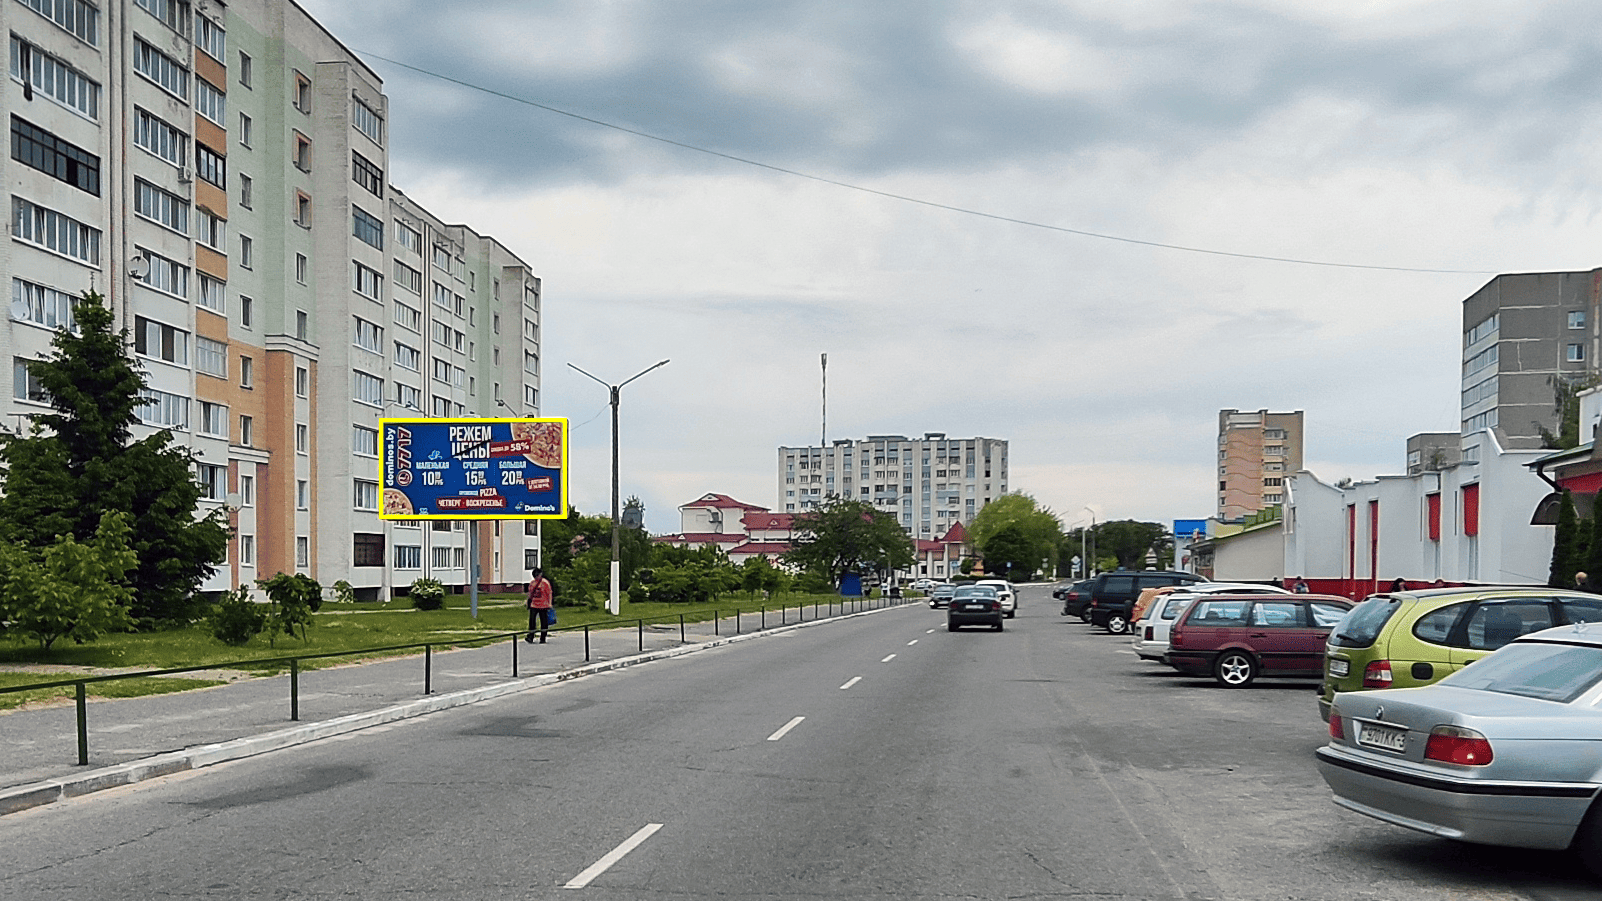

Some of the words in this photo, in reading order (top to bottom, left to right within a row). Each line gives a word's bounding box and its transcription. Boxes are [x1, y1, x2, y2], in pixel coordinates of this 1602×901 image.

[449, 426, 491, 441] РЕЖЕМ
[397, 426, 412, 469] 7717
[451, 442, 490, 461] ЦЕНЫ
[510, 442, 530, 452] 58%
[386, 428, 396, 486] dominos.by
[479, 487, 497, 497] PIZZA
[524, 504, 556, 512] Domino's
